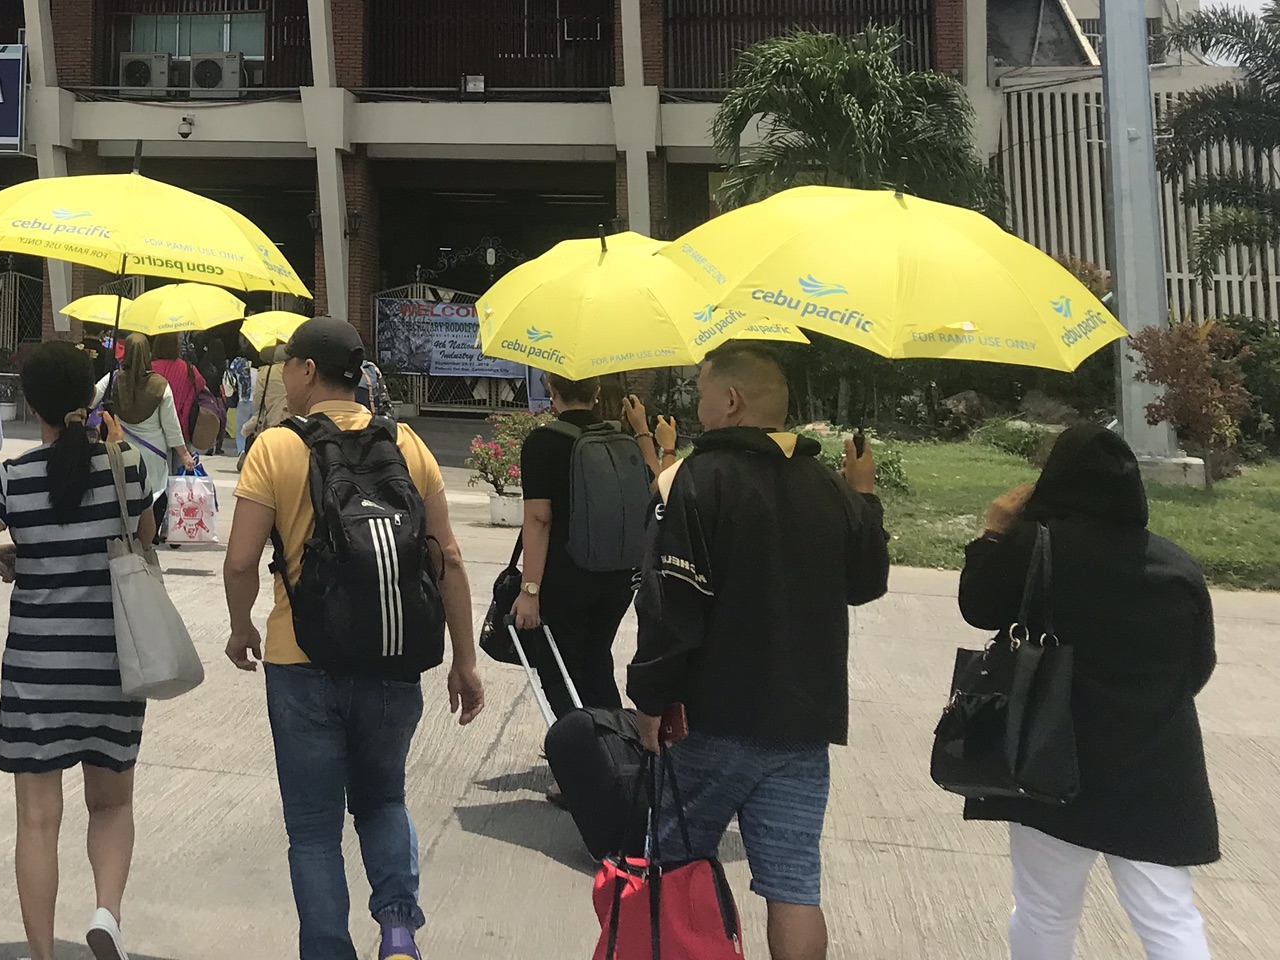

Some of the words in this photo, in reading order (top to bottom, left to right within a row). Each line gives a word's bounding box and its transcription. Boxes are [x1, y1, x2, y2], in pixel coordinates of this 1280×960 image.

[12, 218, 52, 231] cebu
[53, 224, 114, 239] pacific
[144, 238, 163, 247] FOR
[198, 246, 215, 256] USE
[219, 250, 245, 262] ONLY
[399, 303, 478, 318] WELCO
[751, 289, 801, 310] cebu
[801, 301, 874, 333] pacific
[694, 327, 717, 346] cebu
[1060, 326, 1084, 348] cebu
[1079, 309, 1107, 340] pacific
[433, 340, 447, 350] 4th
[912, 330, 937, 342] FOR
[939, 333, 974, 345] RAMP
[978, 336, 1003, 347] USE
[1006, 338, 1037, 351] ONLY
[439, 350, 474, 361] Industry
[501, 338, 527, 353] cebu
[527, 346, 566, 365] pacific
[591, 356, 608, 366] FOR
[610, 352, 634, 362] RAMP
[636, 350, 653, 359] USE
